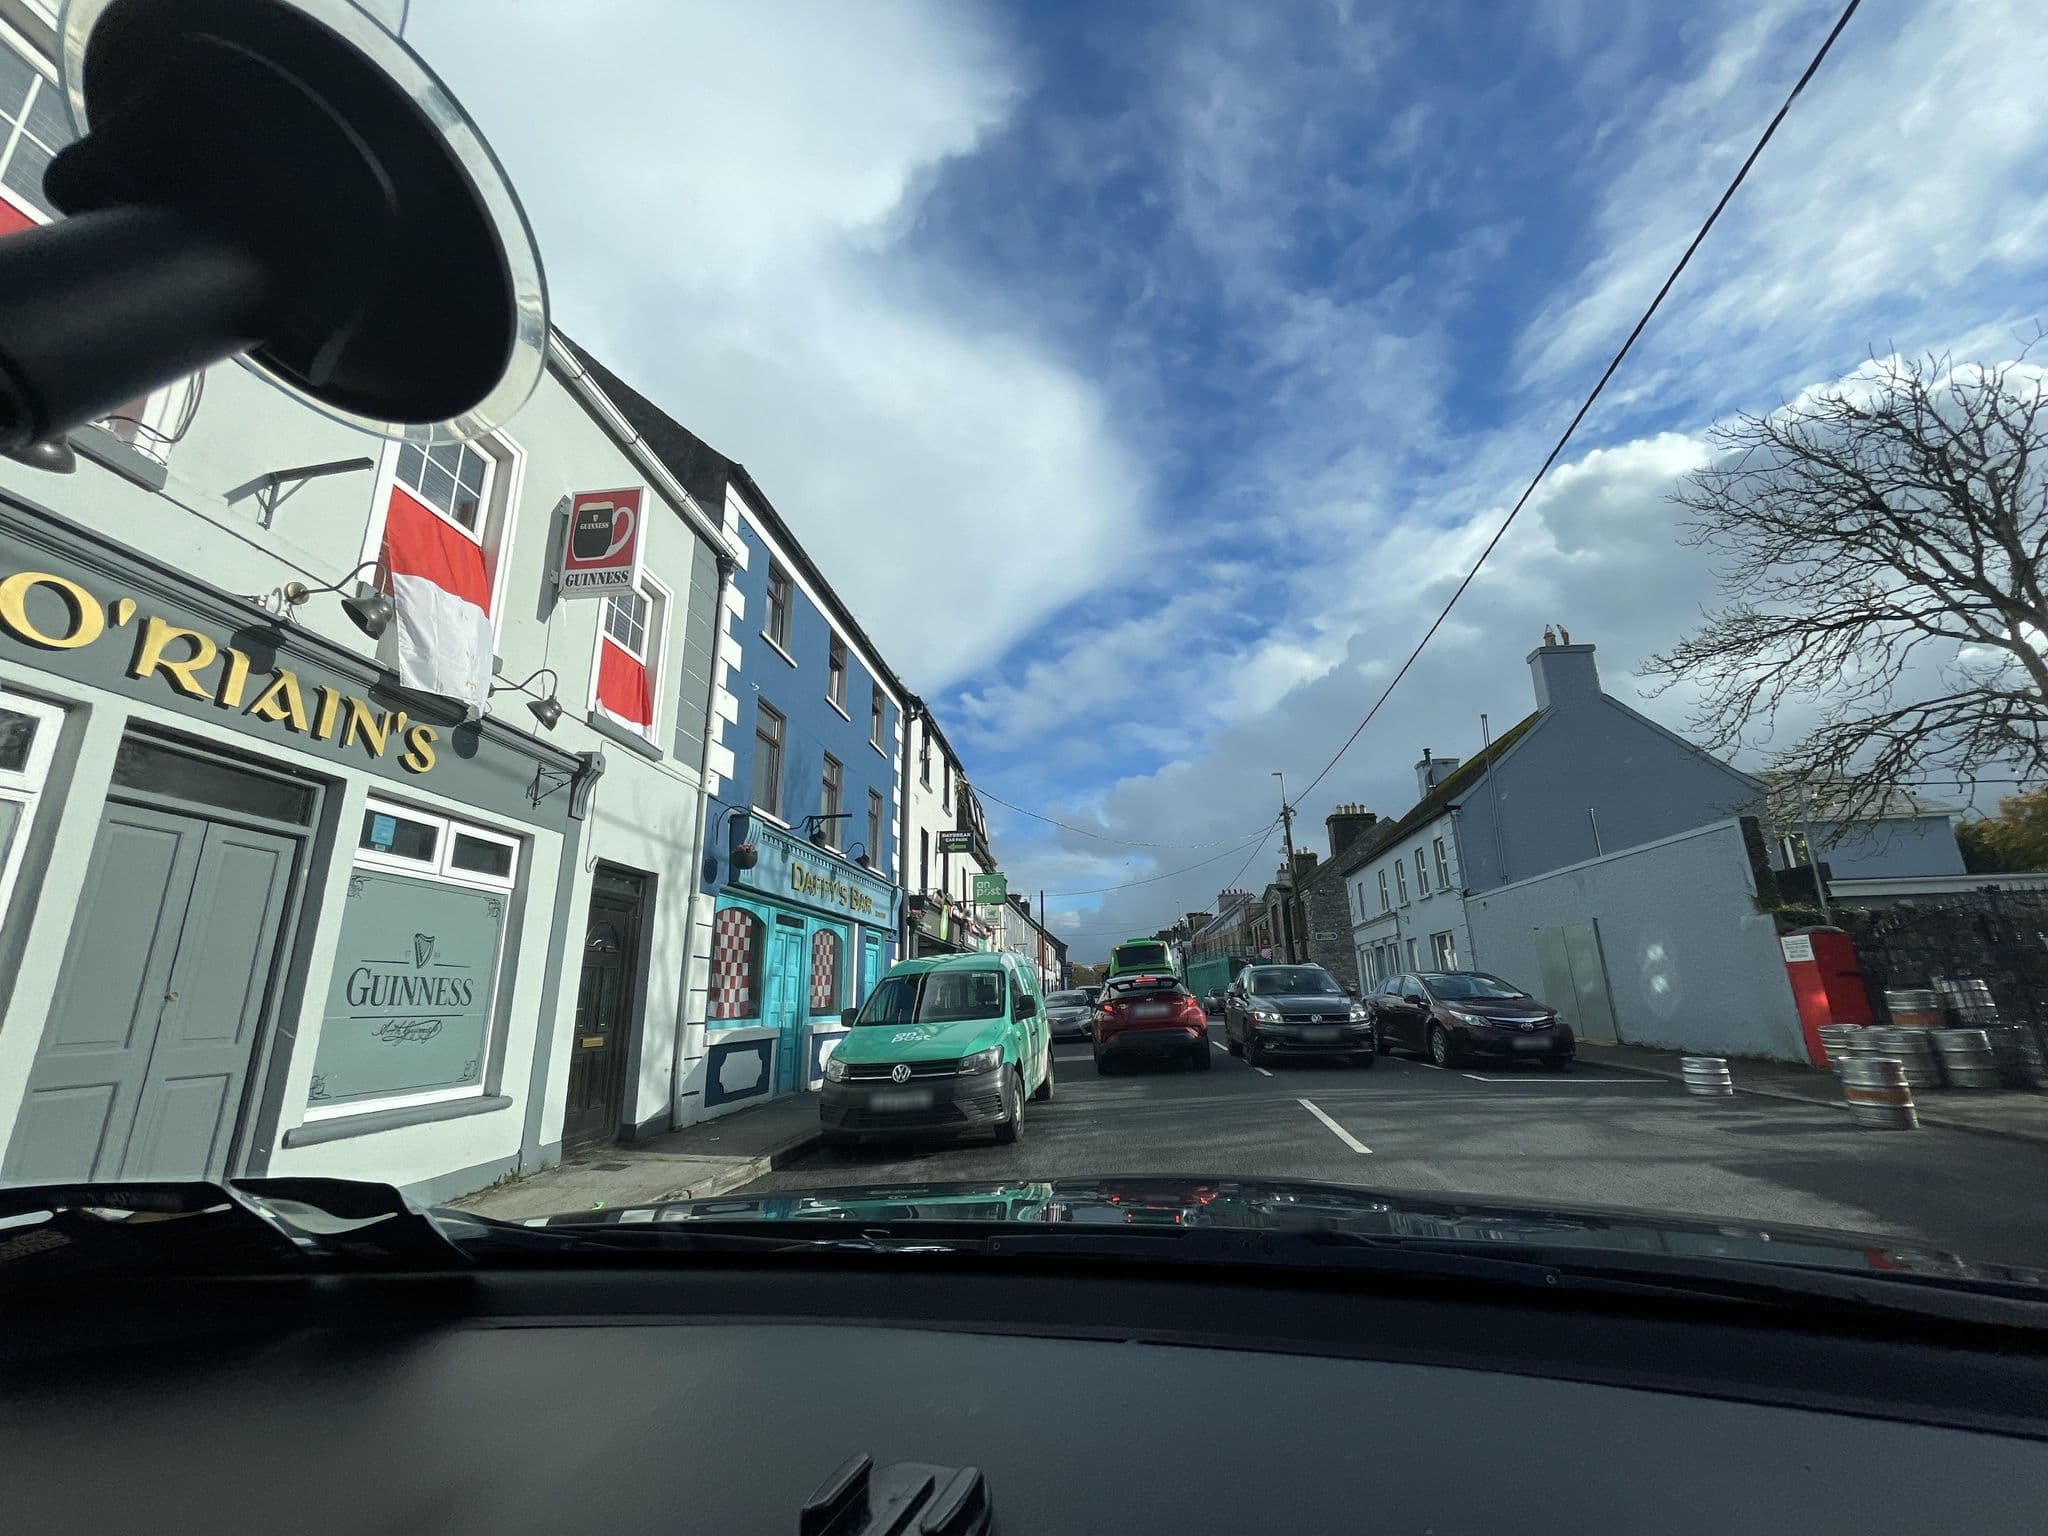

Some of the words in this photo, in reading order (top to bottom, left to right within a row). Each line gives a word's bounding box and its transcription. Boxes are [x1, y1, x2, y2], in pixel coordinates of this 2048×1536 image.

[565, 570, 629, 587] GUINNESS
[0, 571, 440, 773] O'RIAIN'S
[976, 881, 991, 889] an
[976, 886, 1001, 897] post
[346, 967, 474, 1007] GUINNESS
